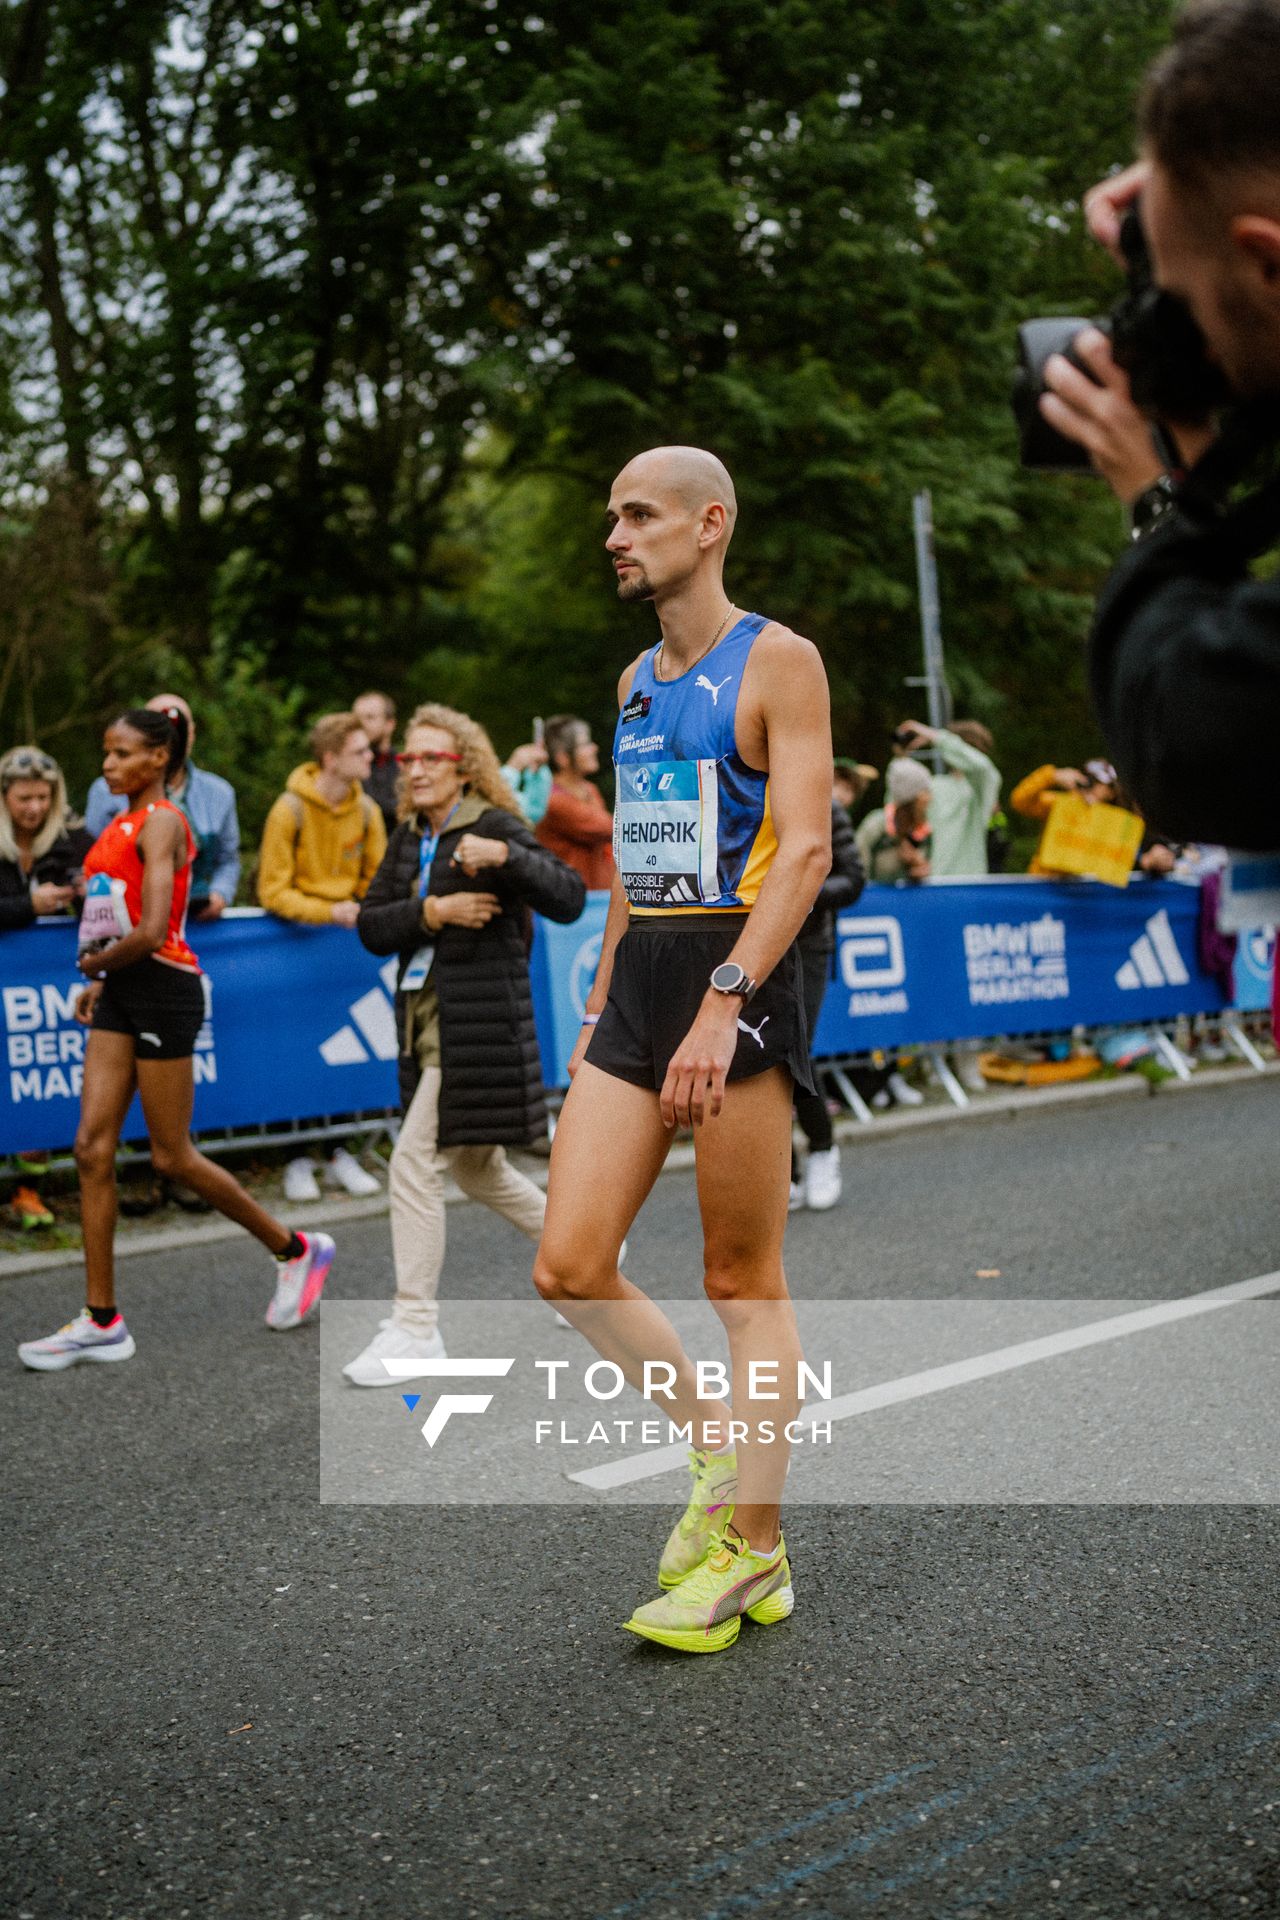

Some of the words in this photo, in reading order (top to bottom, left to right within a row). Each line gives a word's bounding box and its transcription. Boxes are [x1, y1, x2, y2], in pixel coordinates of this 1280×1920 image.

[622, 821, 697, 843] HENDRIK
[645, 855, 657, 866] 40
[629, 889, 662, 902] NOTHING
